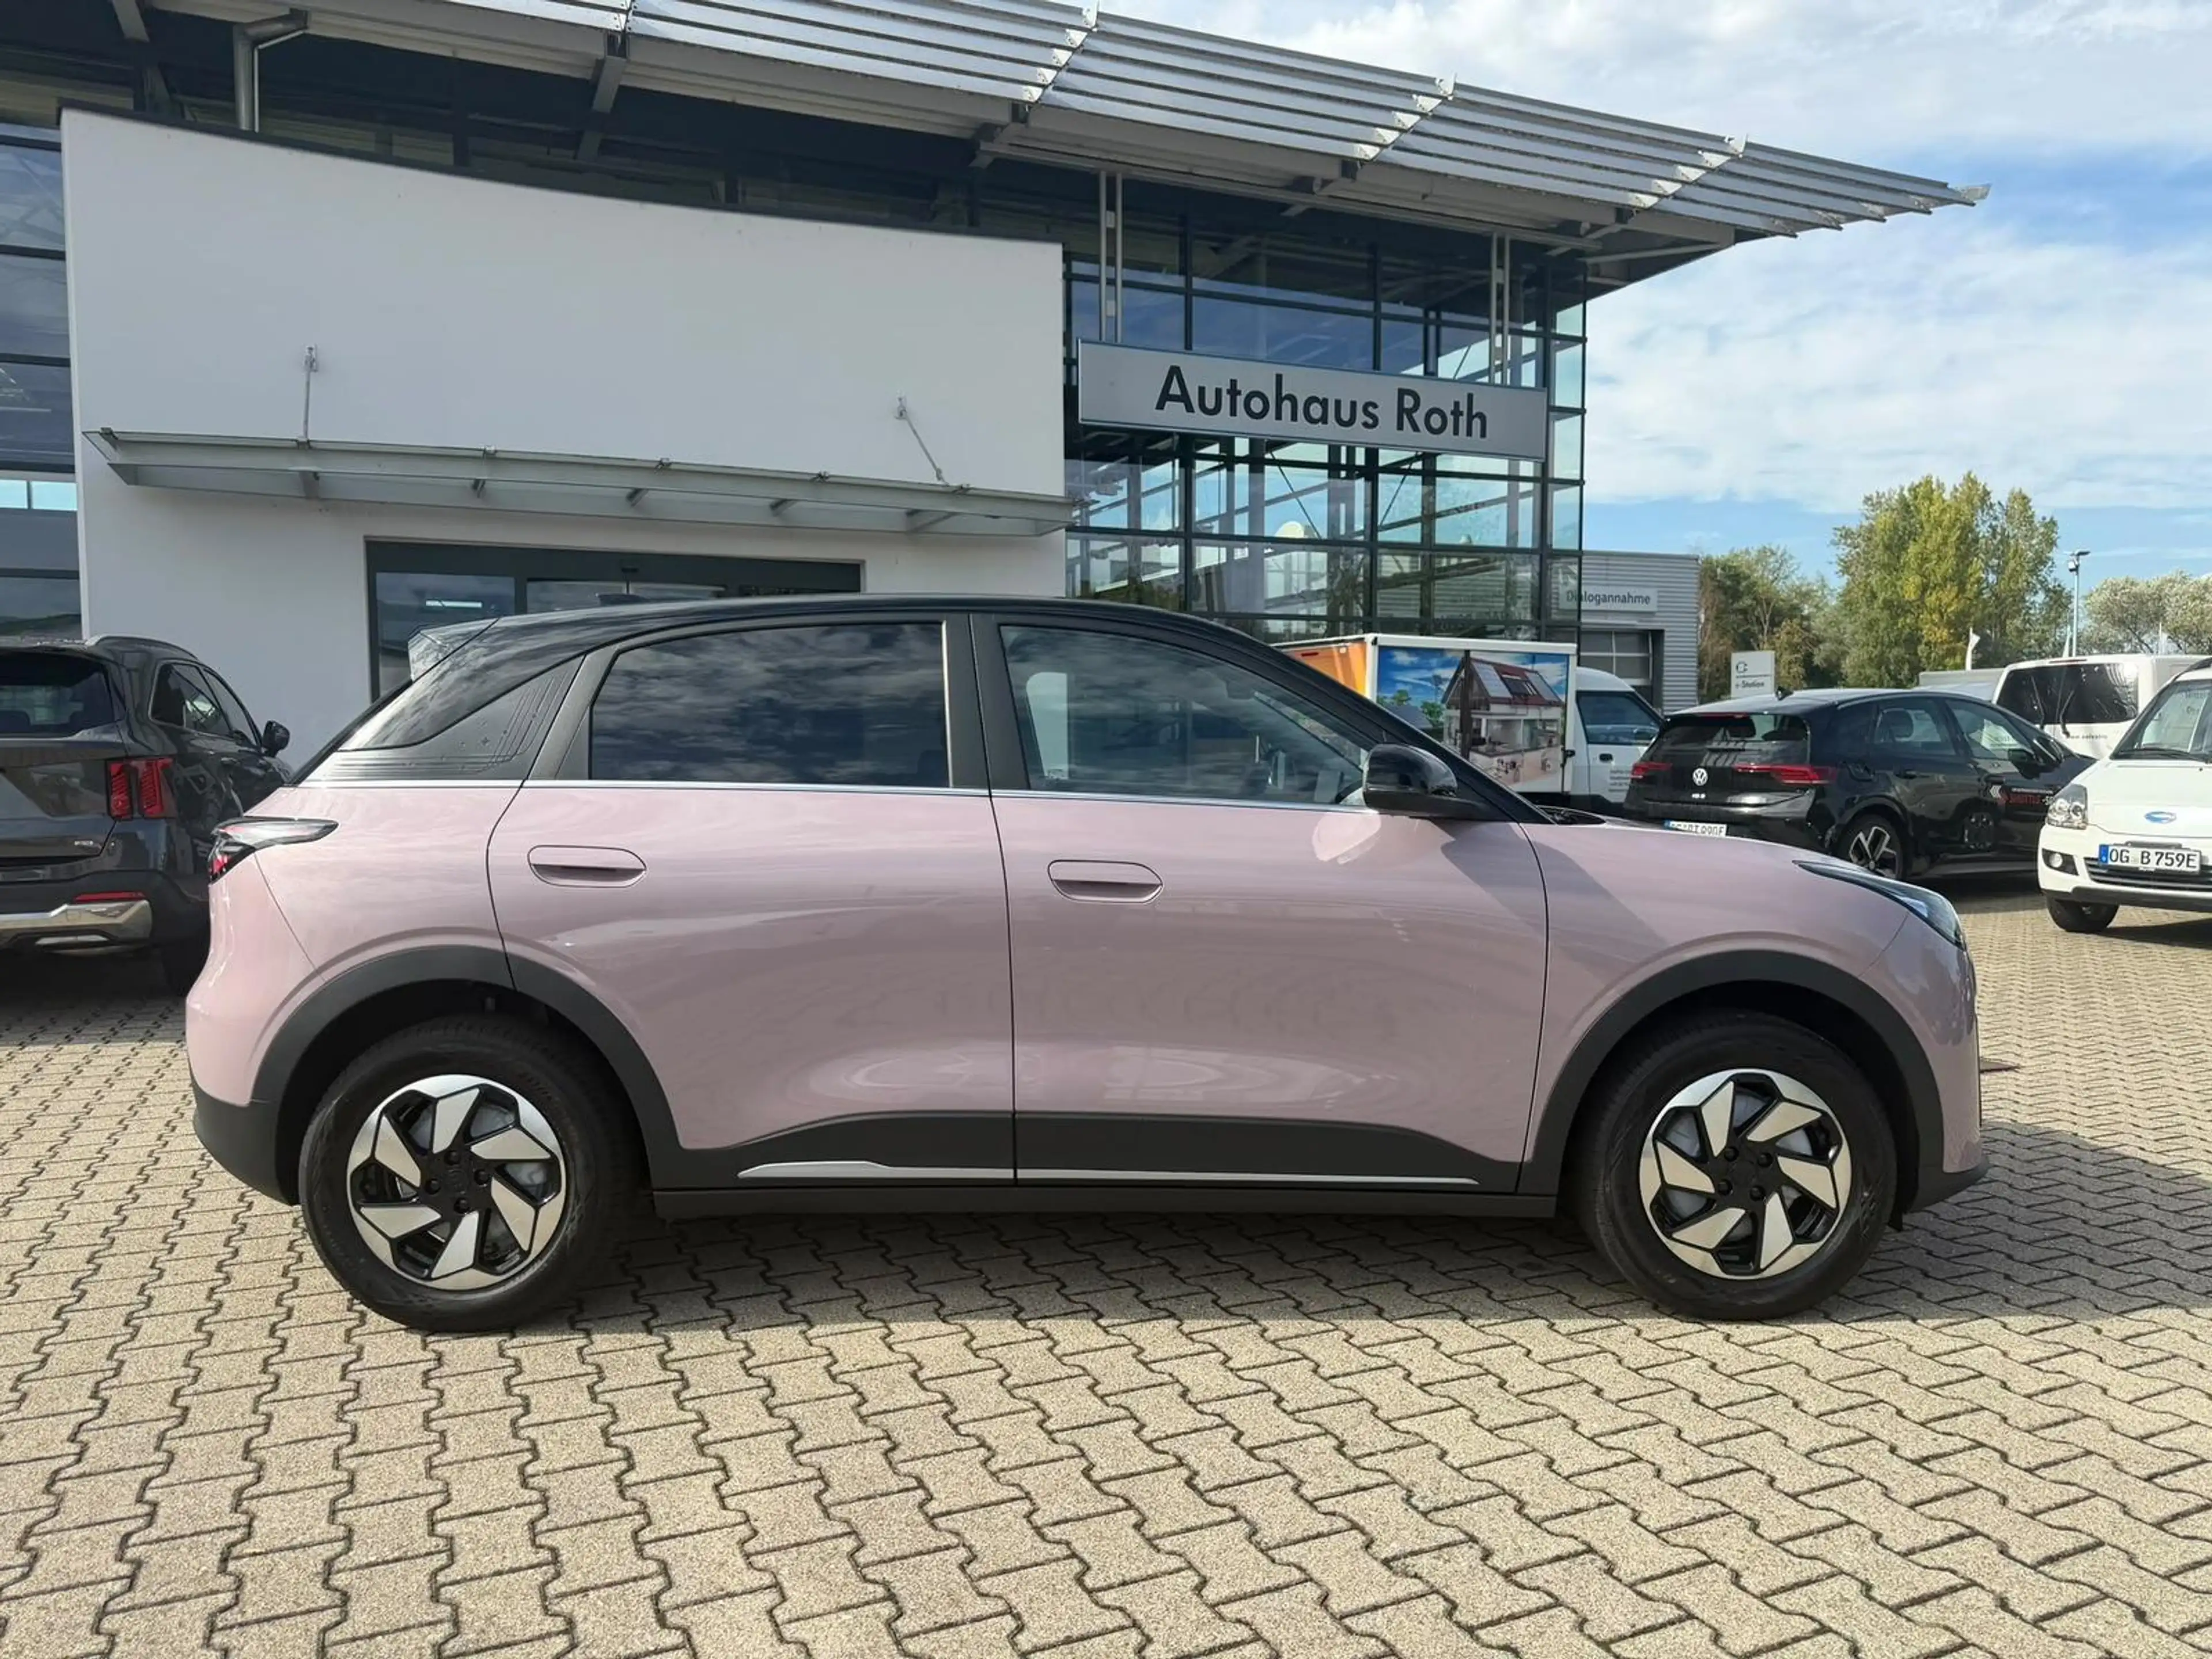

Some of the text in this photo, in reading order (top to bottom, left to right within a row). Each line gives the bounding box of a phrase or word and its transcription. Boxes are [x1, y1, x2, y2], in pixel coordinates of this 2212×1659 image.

[1154, 365, 1487, 439] Autohaus Roth
[1566, 590, 1650, 605] Dilogannahme
[2109, 849, 2198, 869] OG B 759E
